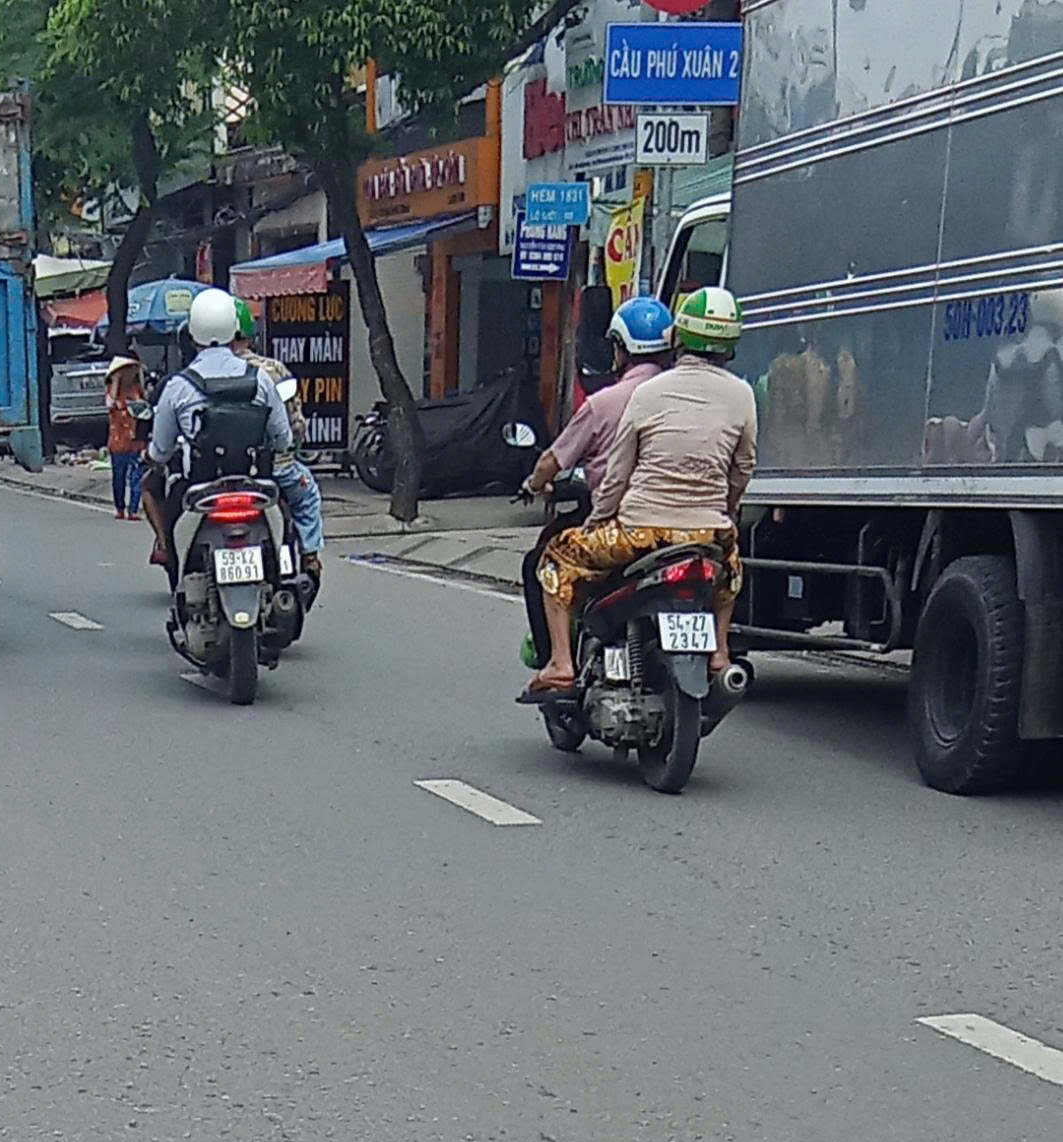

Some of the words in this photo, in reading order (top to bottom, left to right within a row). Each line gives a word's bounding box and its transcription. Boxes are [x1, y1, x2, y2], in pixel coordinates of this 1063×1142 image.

[610, 38, 641, 78] CẦU
[647, 42, 677, 78] PHÚ
[682, 45, 723, 78] XUÂN
[729, 50, 739, 78] 2
[642, 120, 700, 153] 200m
[272, 336, 306, 363] THAY
[310, 331, 343, 363] MÀN
[315, 377, 342, 403] PIN
[669, 632, 709, 649] 2347
